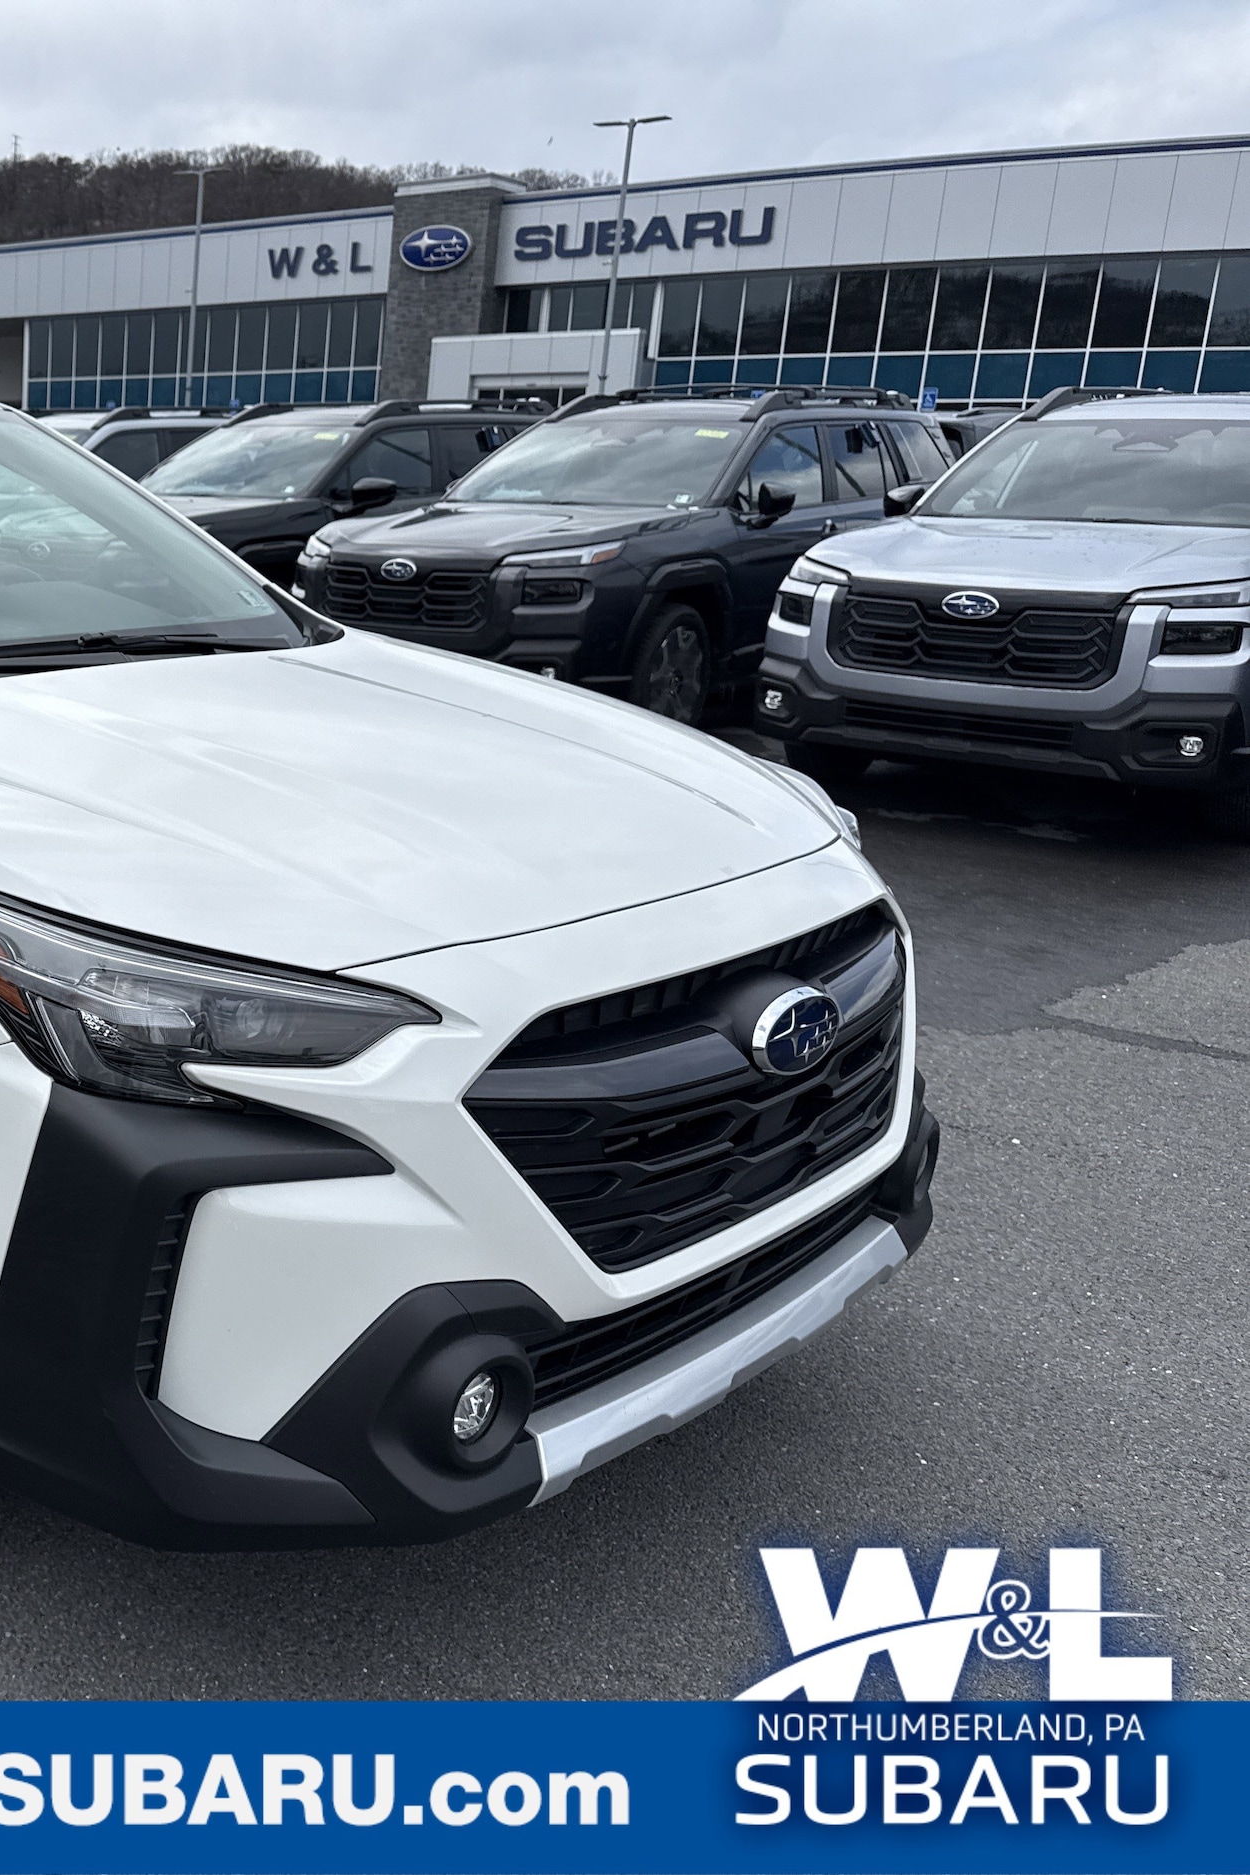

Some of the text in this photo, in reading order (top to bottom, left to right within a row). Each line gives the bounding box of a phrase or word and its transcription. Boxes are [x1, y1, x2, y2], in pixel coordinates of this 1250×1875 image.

[514, 206, 775, 261] SUBARU
[268, 242, 373, 279] W & L
